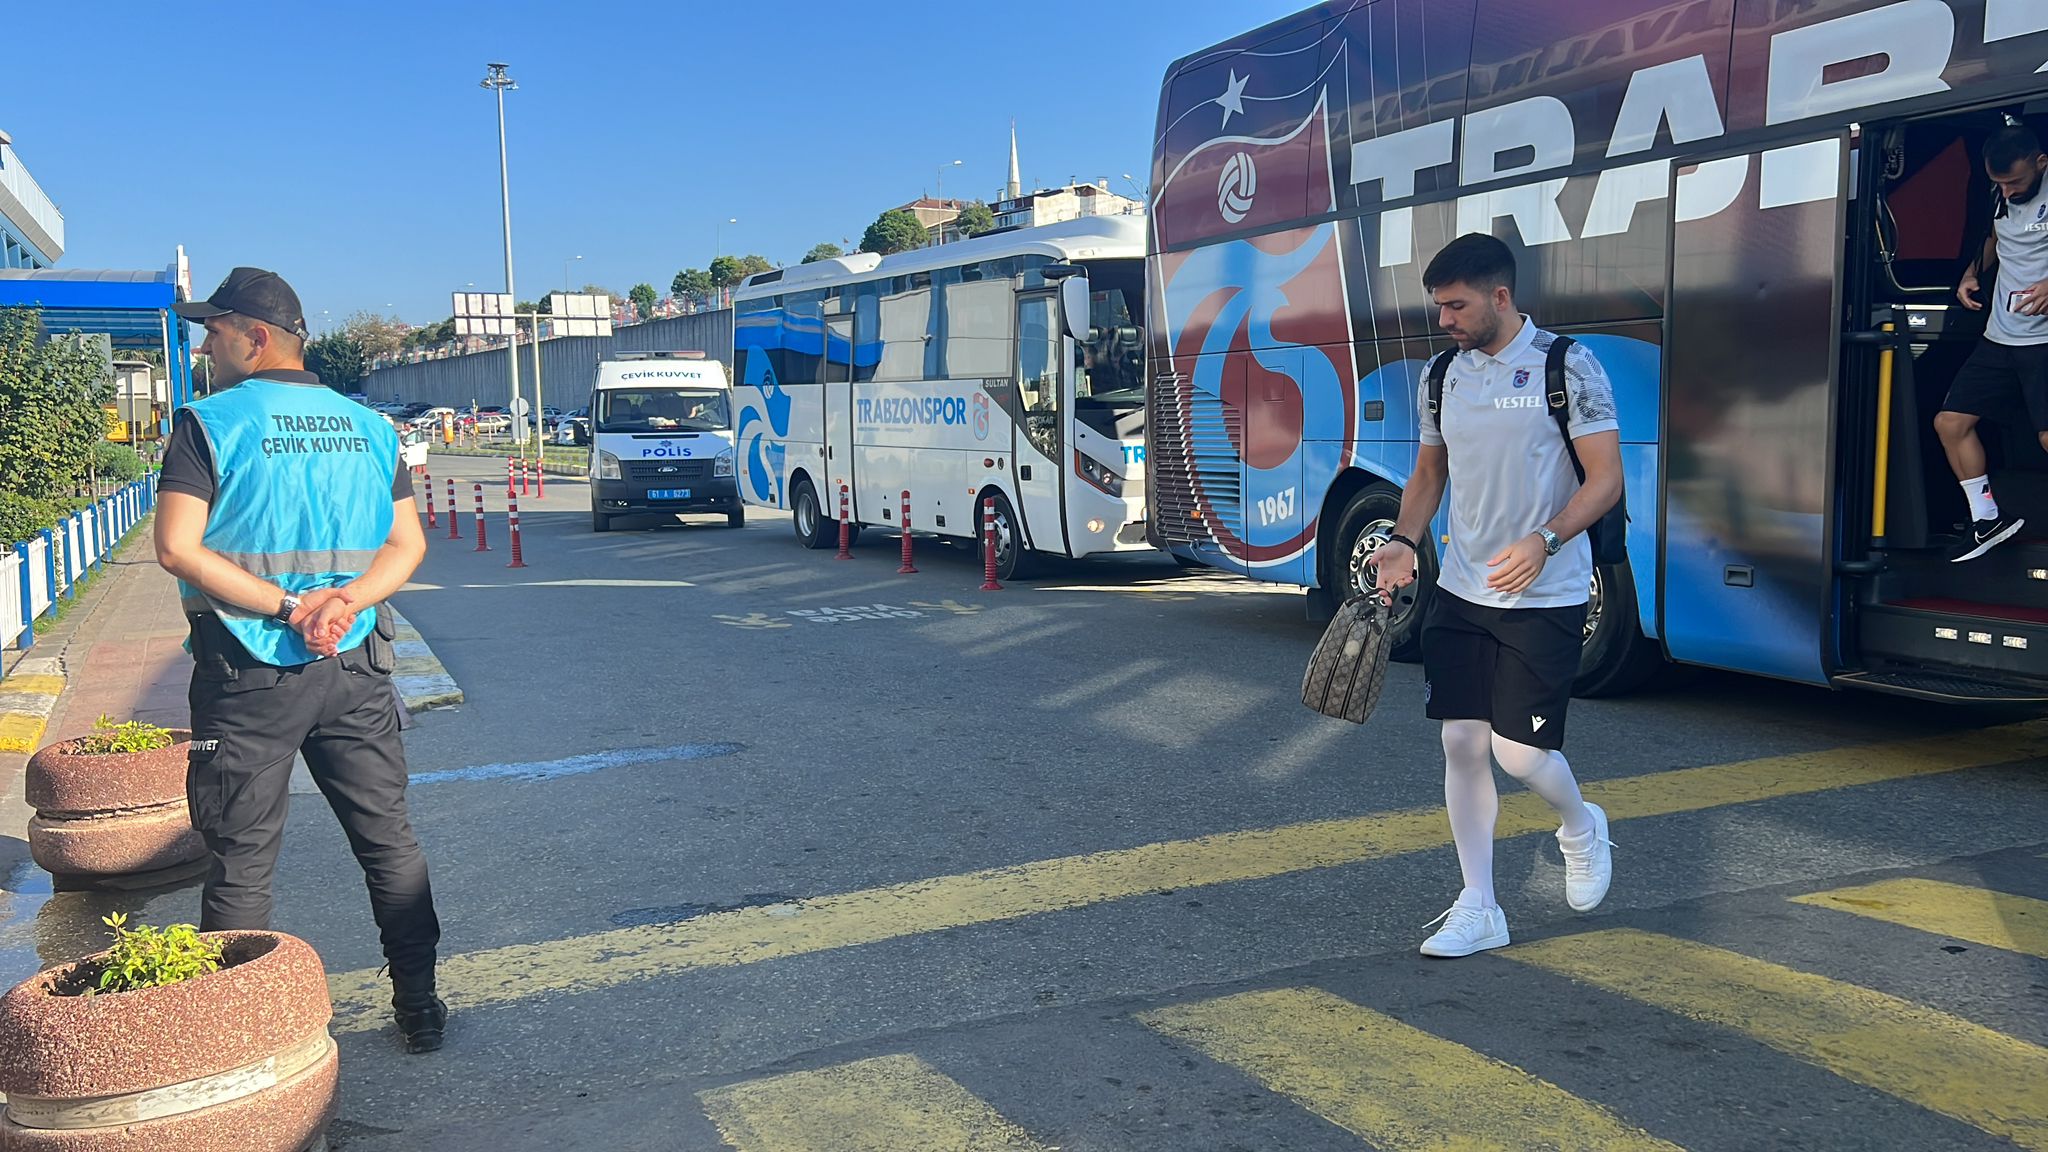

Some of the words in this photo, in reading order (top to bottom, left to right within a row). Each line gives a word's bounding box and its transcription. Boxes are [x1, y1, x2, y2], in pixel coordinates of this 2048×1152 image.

[621, 371, 654, 380] ÇEVİK
[656, 370, 702, 379] KUVVET
[985, 378, 1009, 388] SULTAN
[856, 396, 967, 425] TRABZONSPOR
[1493, 395, 1543, 409] VESTEL
[271, 414, 354, 433] TRABZON
[261, 434, 308, 459] ÇEVİK
[310, 437, 370, 453] KUVVET
[642, 446, 692, 458] POLİS
[1120, 445, 1146, 465] TR
[1257, 486, 1295, 527] 1967
